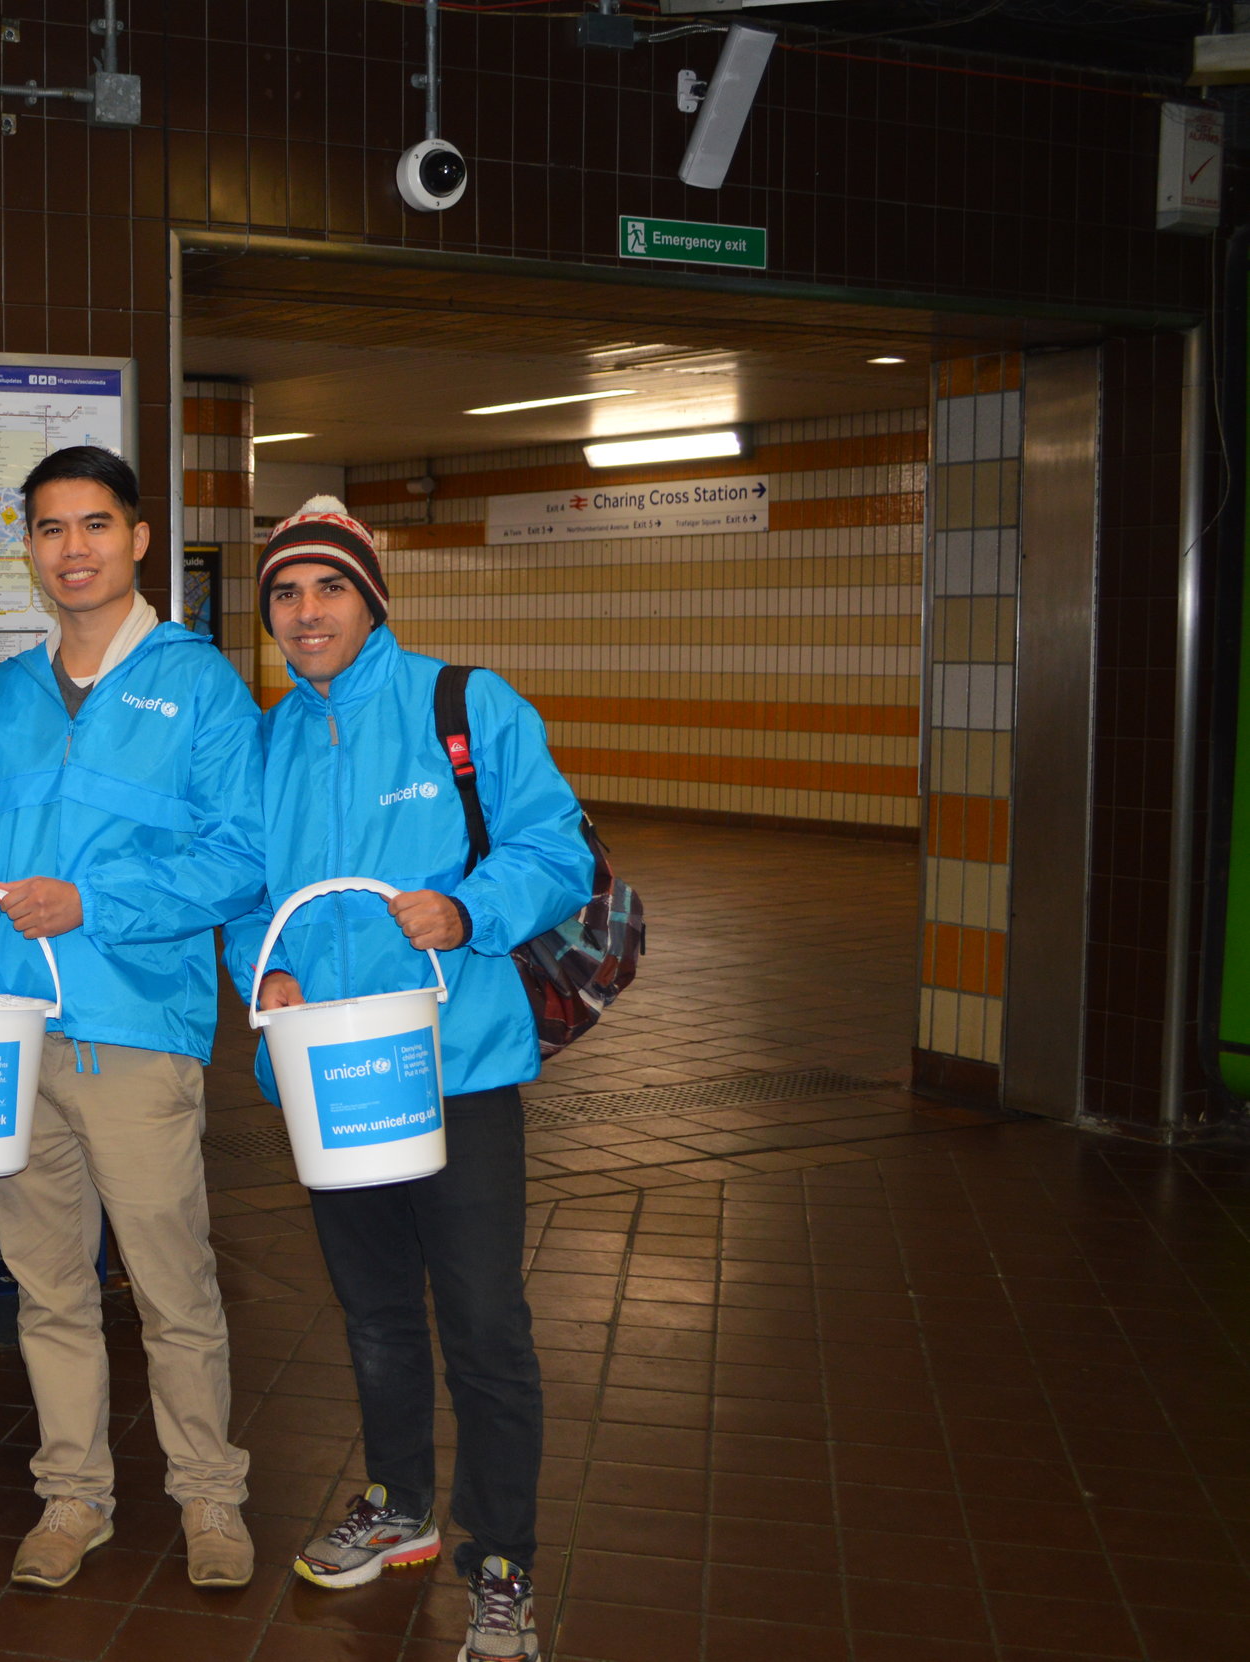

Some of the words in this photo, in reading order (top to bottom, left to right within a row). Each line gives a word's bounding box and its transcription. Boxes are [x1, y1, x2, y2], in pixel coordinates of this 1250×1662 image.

[652, 231, 721, 252] Emergency
[725, 238, 747, 252] exit
[593, 492, 645, 510] Charing
[649, 489, 689, 506] Cross
[693, 485, 748, 503] Station
[546, 503, 560, 513] Exit
[560, 503, 565, 512] 4
[675, 518, 700, 528] Trafalgar
[701, 518, 721, 527] Square
[726, 515, 742, 524] Exit
[742, 514, 748, 523] 6
[566, 525, 608, 533] Northumberland
[633, 520, 648, 530] Exit
[649, 519, 654, 528] 5
[527, 527, 539, 535] Exit
[121, 691, 162, 714] unicef
[379, 783, 418, 807] unicef
[401, 1044, 422, 1054] Denying
[416, 1050, 428, 1060] rights
[410, 1060, 426, 1068] wrong.
[324, 1060, 371, 1080] unicef
[418, 1066, 430, 1074] right.
[332, 1106, 437, 1135] www.unicef.org.uk
